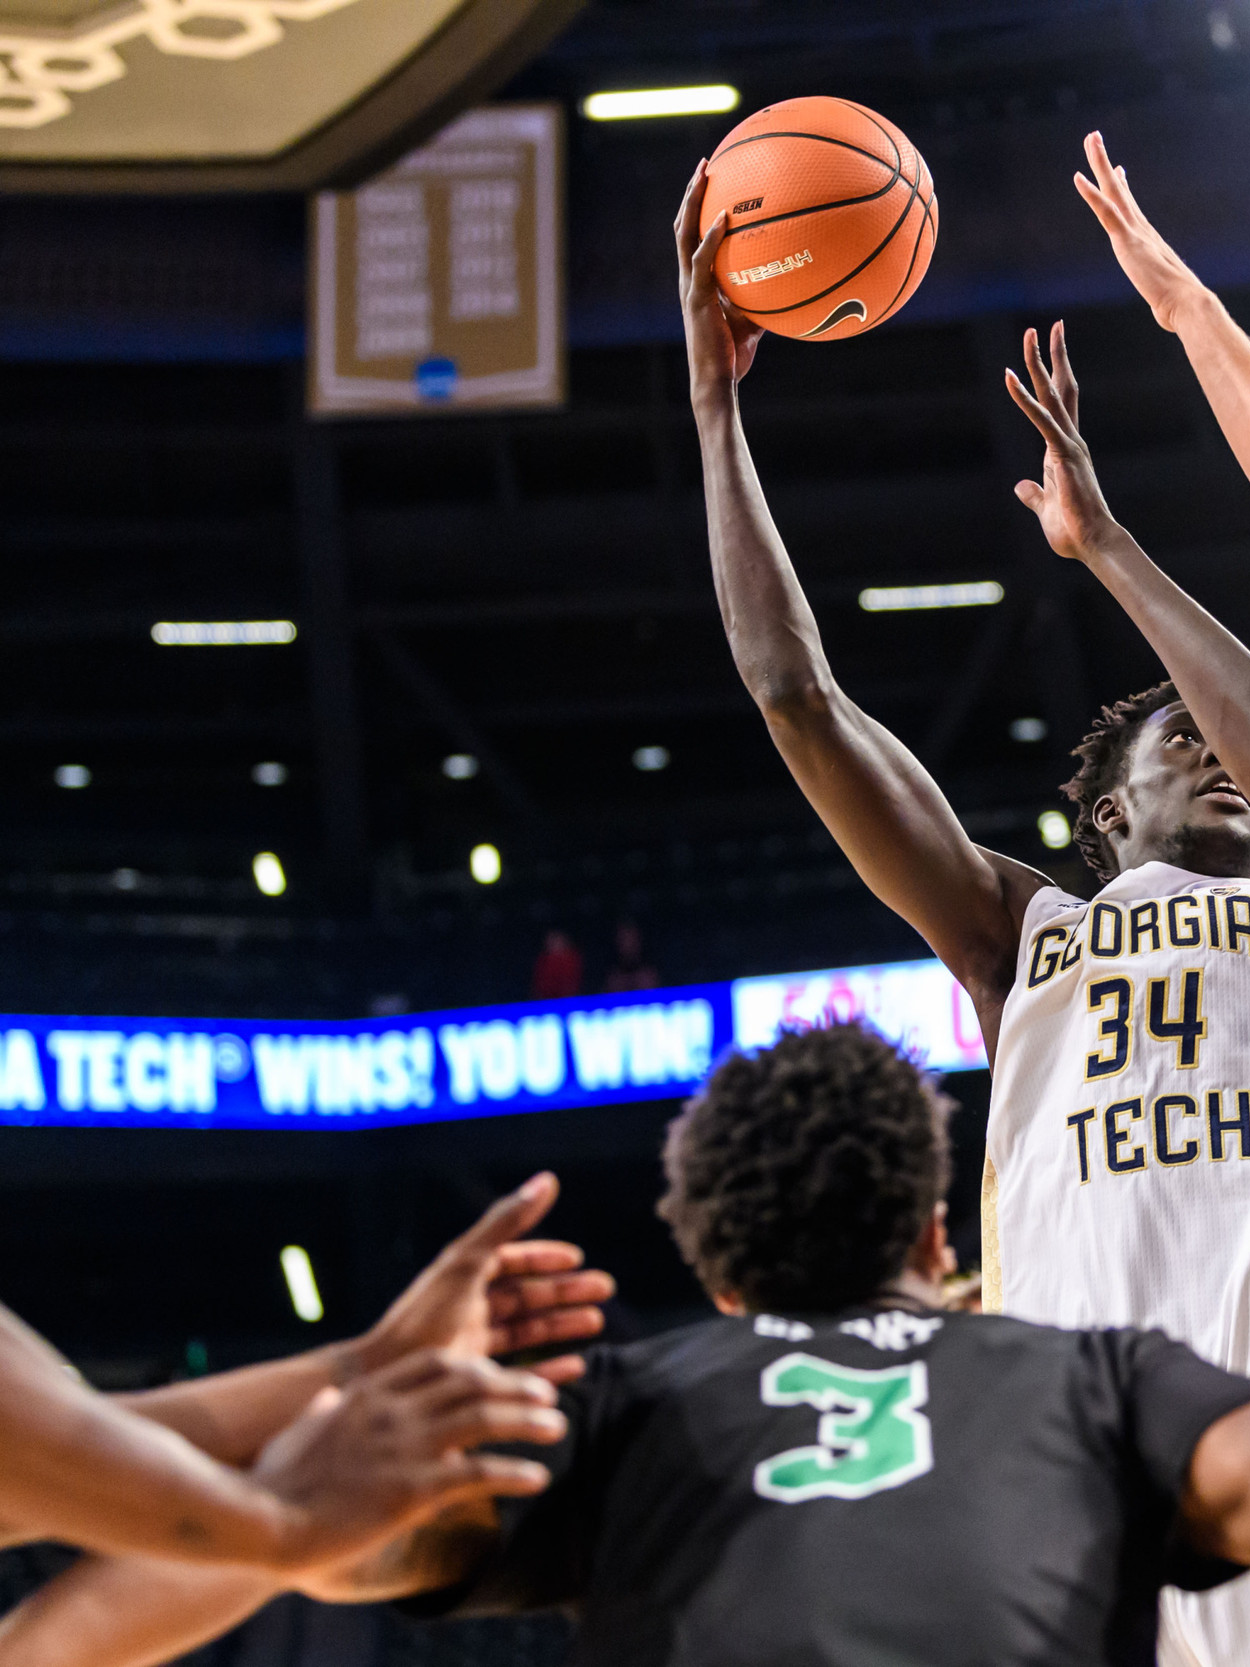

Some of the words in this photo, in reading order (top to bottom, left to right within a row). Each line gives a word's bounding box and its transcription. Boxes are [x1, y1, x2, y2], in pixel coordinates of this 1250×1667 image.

[252, 1025, 435, 1115] WINS!
[438, 1013, 565, 1104] YOU
[567, 998, 713, 1091] WIN!
[1084, 968, 1208, 1083] 34
[754, 1352, 934, 1503] 3
